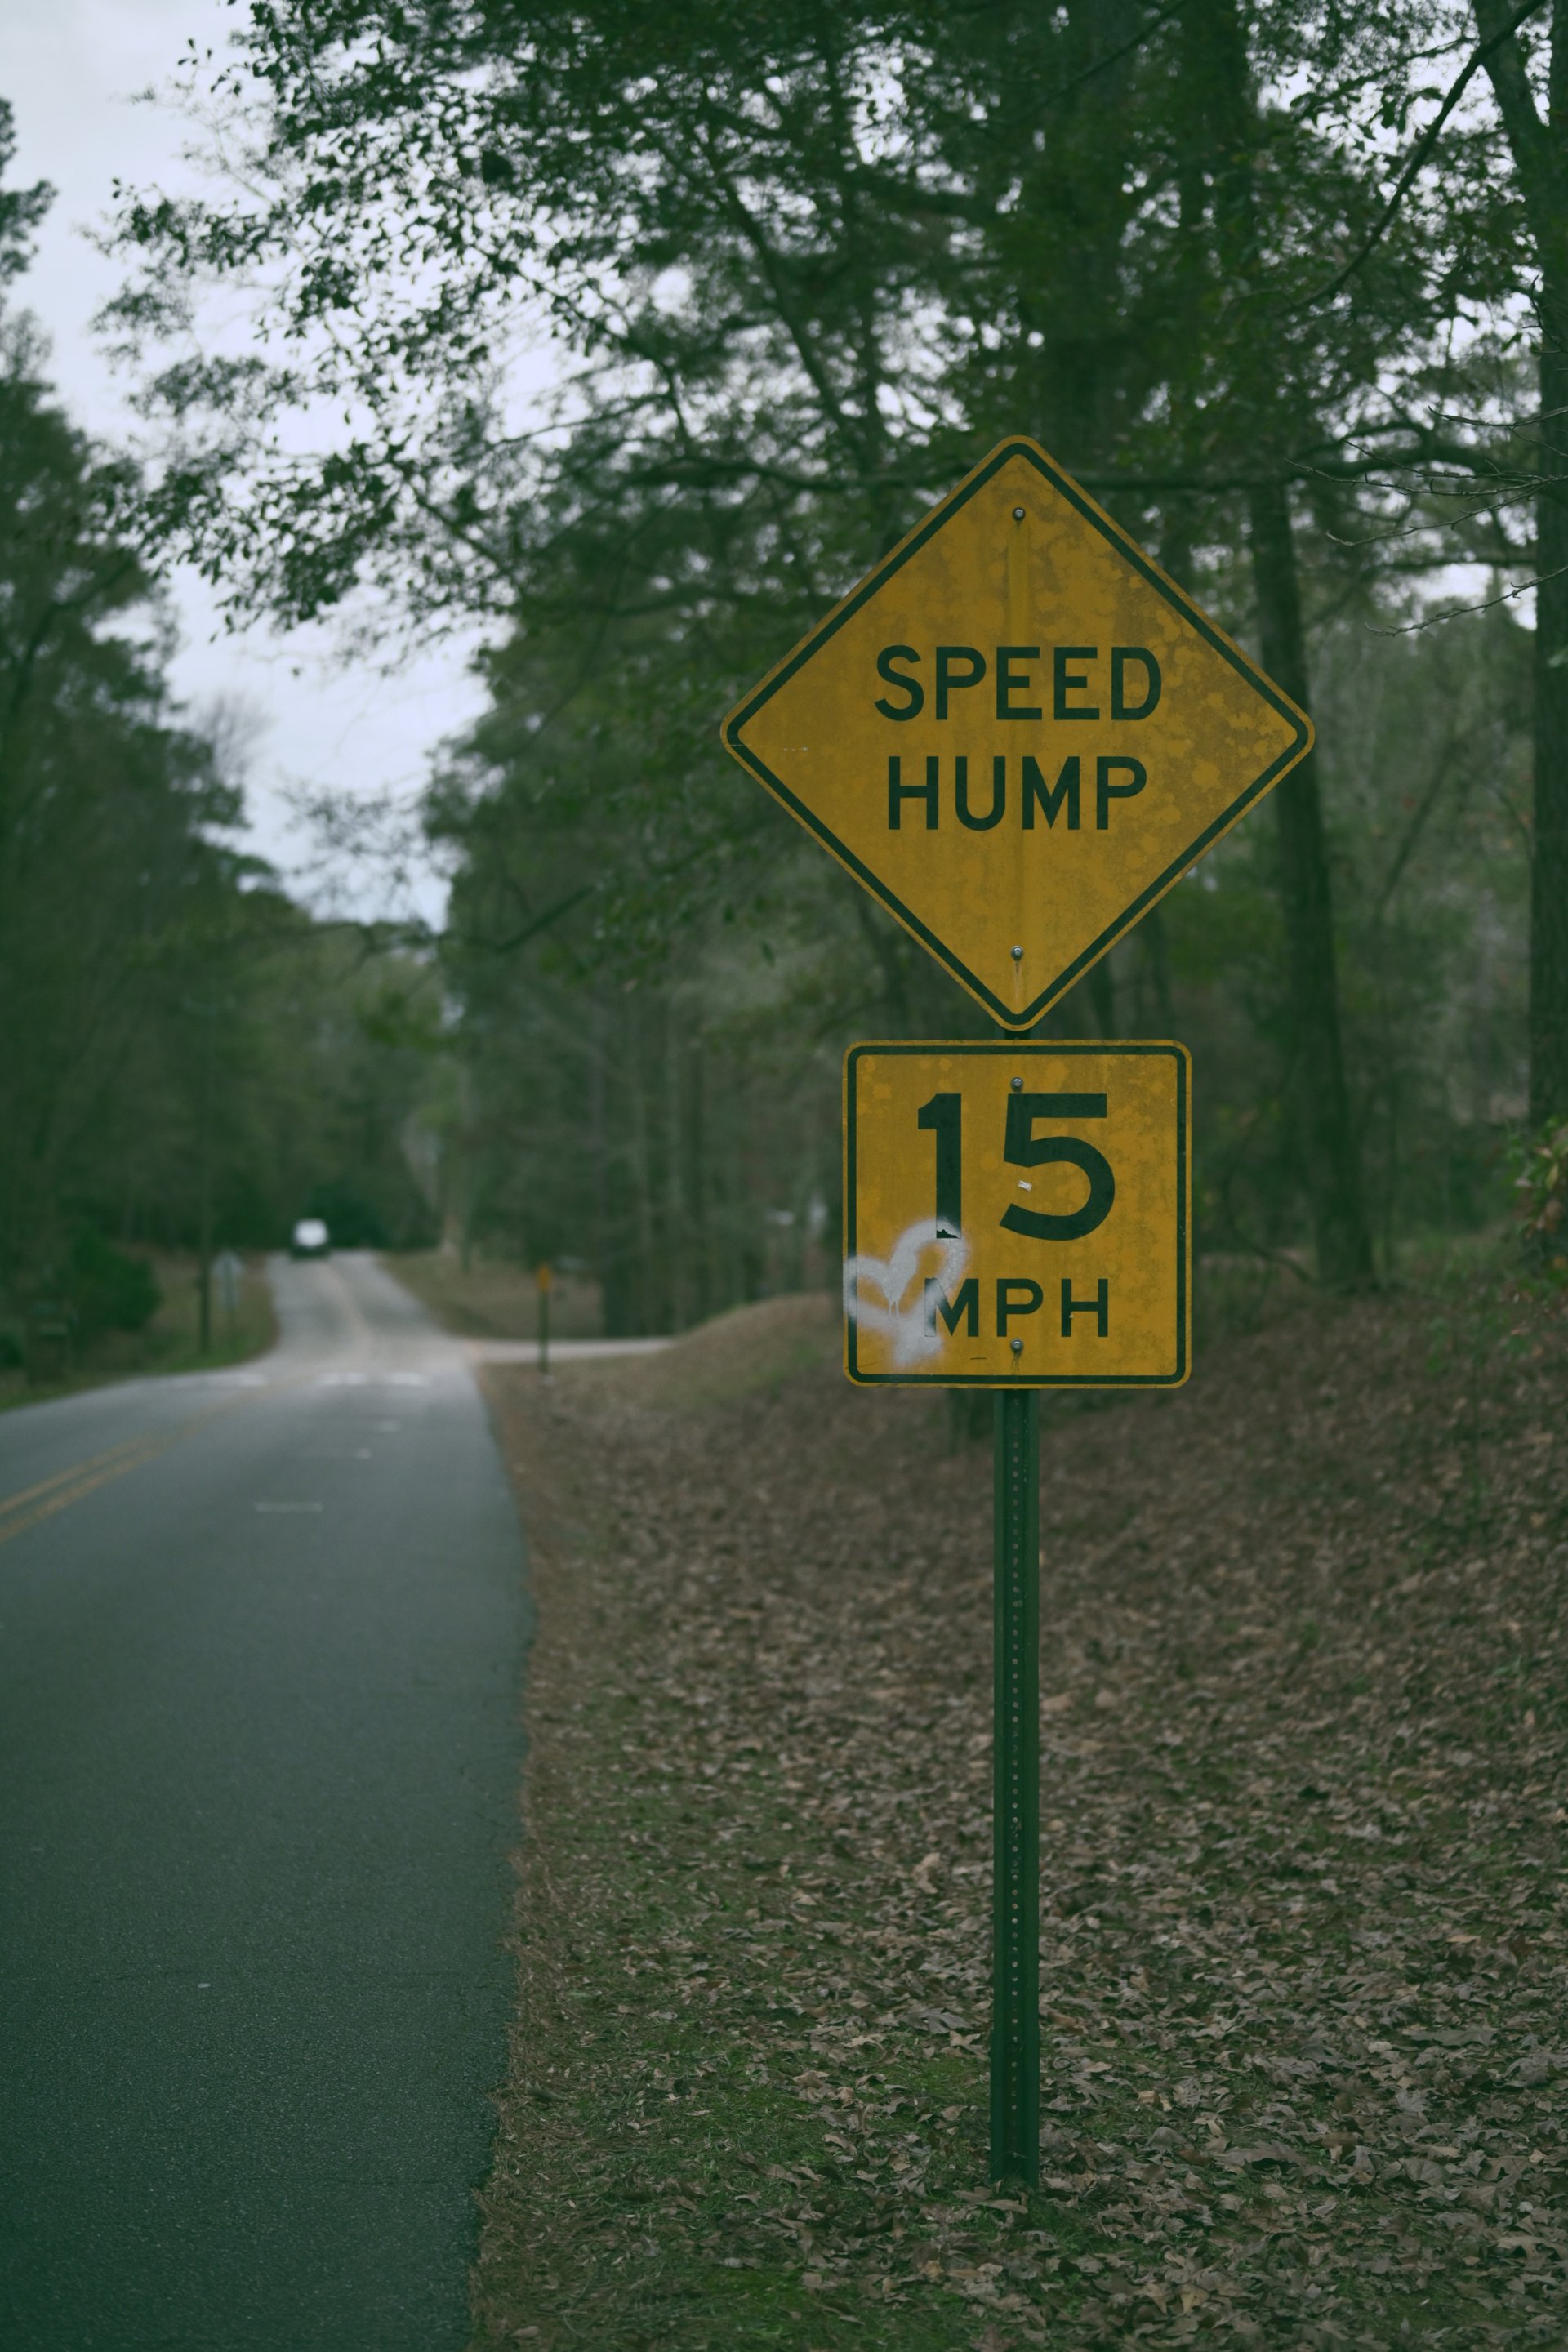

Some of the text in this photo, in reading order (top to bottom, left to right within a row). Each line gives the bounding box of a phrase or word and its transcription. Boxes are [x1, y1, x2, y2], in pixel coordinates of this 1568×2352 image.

[874, 644, 1162, 721] SPEED
[887, 755, 1147, 831] HUMP
[917, 1092, 1116, 1241] 15
[924, 1278, 1109, 1338] MPH
